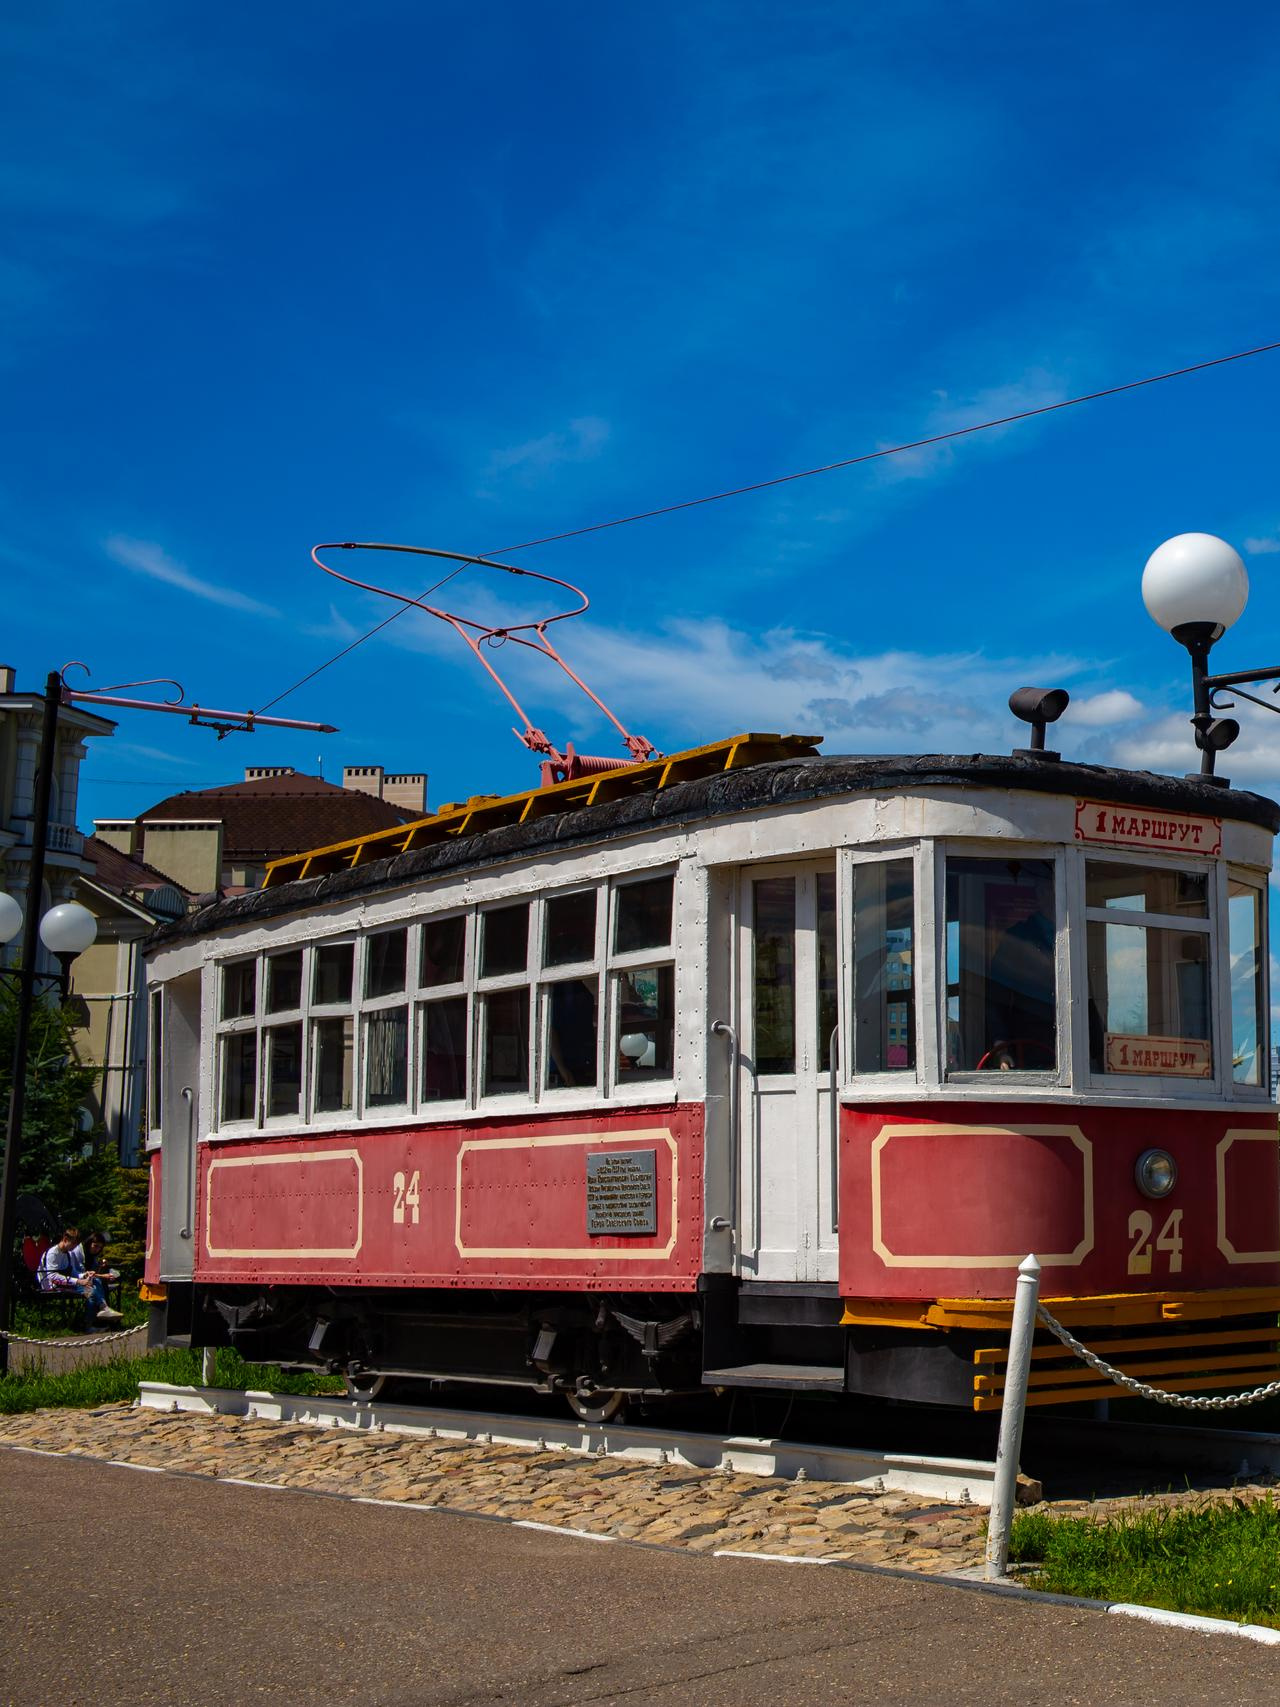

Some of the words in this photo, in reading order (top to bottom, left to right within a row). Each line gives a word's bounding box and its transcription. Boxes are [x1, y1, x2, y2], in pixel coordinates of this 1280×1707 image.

[1096, 811, 1107, 832] 1
[1112, 815, 1203, 843] МАРШРУТ
[1120, 1044, 1129, 1066] 1
[1132, 1050, 1197, 1069] МАРШРУТ
[393, 1170, 420, 1224] 24
[1127, 1209, 1183, 1275] 24
